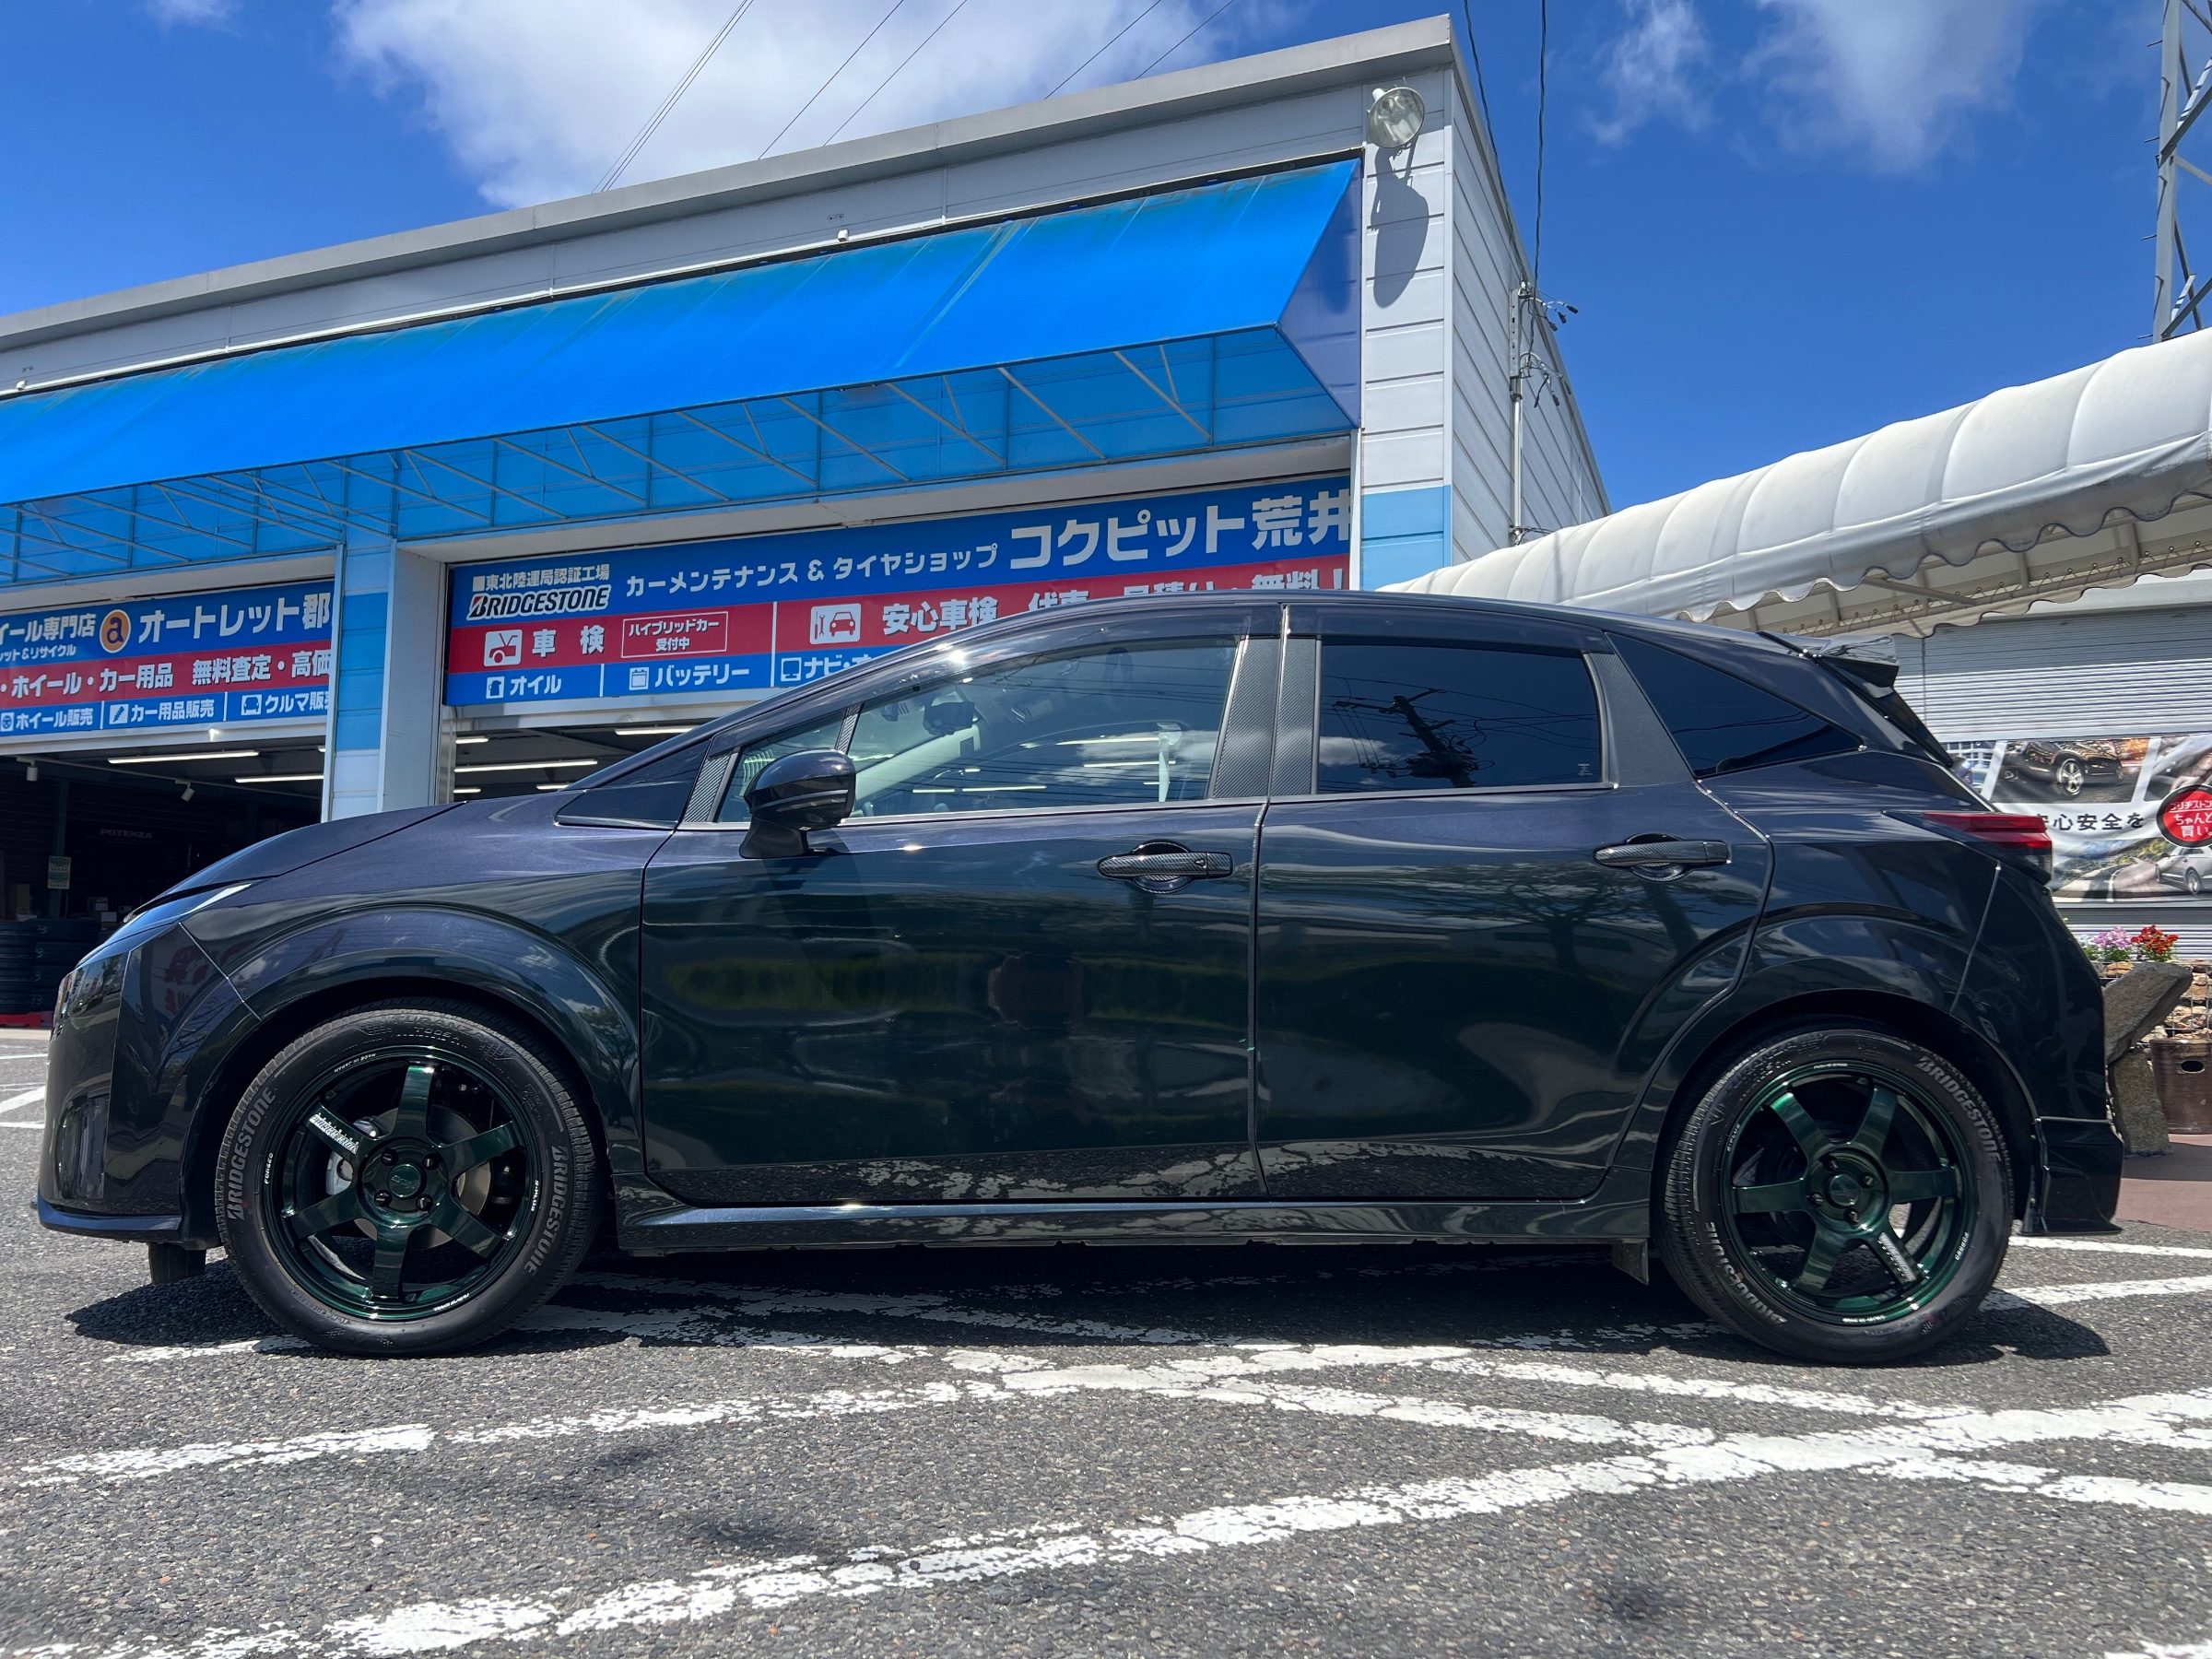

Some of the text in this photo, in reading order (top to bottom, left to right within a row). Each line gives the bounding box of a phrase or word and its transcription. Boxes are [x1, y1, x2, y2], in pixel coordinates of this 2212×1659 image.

[1010, 488, 1349, 570] コクピット荒井
[627, 542, 997, 597] カーメンテナンス & タイヤショップ
[468, 586, 610, 619] BRIDGESTONE
[882, 596, 998, 635] 安心車検
[629, 618, 720, 637] ハイブリッドカー
[655, 637, 690, 652] 受付中
[510, 675, 562, 696] オイル
[654, 664, 749, 688] バッテリー
[16, 708, 93, 730] ホイール販売
[130, 699, 215, 723] カー用品販売
[100, 829, 153, 839] POTENZA
[1916, 1054, 2002, 1162] BRIDGESTONE
[227, 1087, 276, 1222] BRIDGESTONE
[524, 1145, 571, 1277] BRIDGESTONE
